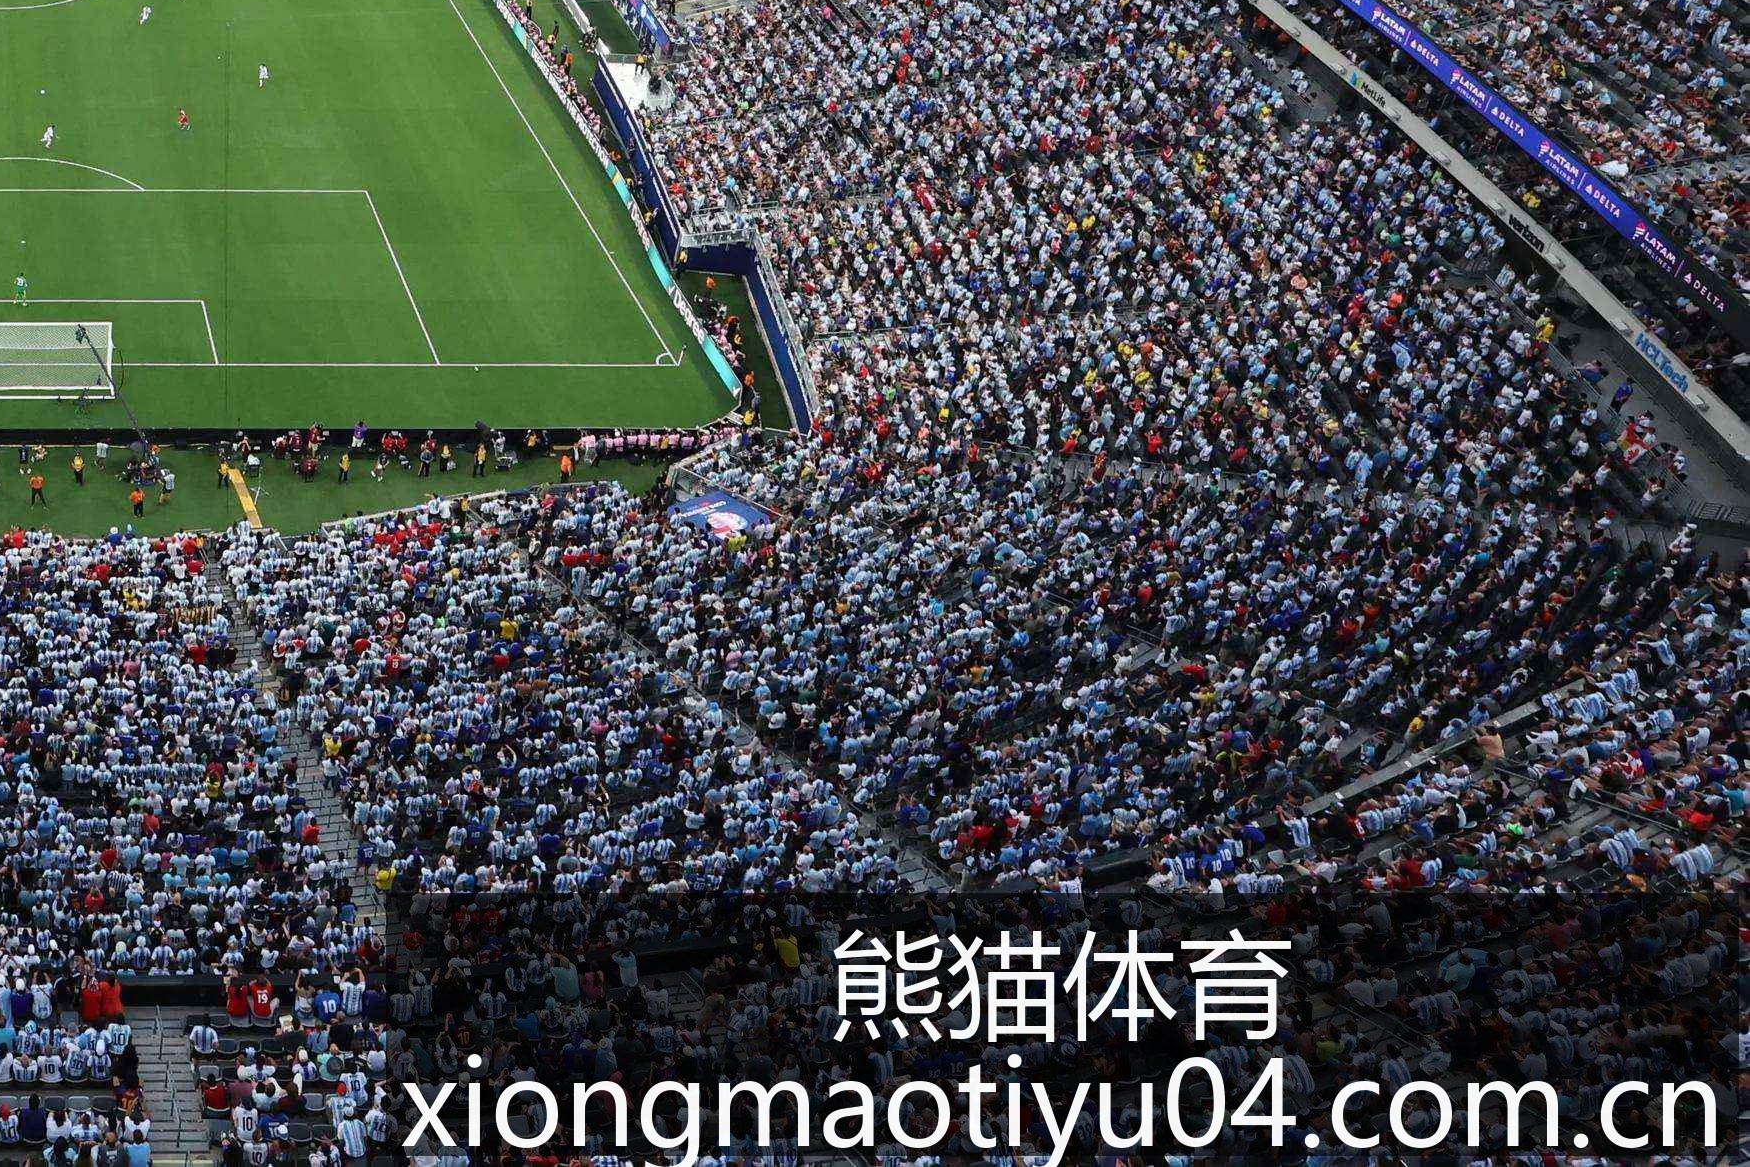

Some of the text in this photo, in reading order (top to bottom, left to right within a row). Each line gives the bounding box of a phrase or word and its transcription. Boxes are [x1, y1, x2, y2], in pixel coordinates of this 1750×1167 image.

[1380, 12, 1406, 35] LATAM
[1416, 43, 1439, 67] DELTA
[1362, 82, 1387, 107] MetLife
[1457, 85, 1482, 109] AIRLINES
[1459, 76, 1486, 101] LATAM
[1499, 112, 1524, 137] DELTA
[1548, 148, 1579, 176] LATAM
[1593, 189, 1621, 218] DELTA
[1509, 214, 1545, 253] verizon
[1645, 231, 1677, 265] LATAM
[1692, 280, 1726, 313] DELTA
[672, 292, 704, 344] Degree
[1636, 332, 1688, 393] HCLTech
[257, 992, 268, 1004] 19
[324, 1000, 336, 1014] 10
[114, 1034, 125, 1046] 10
[45, 1063, 55, 1075] 10
[242, 1116, 253, 1131] 10
[252, 1151, 263, 1164] 10
